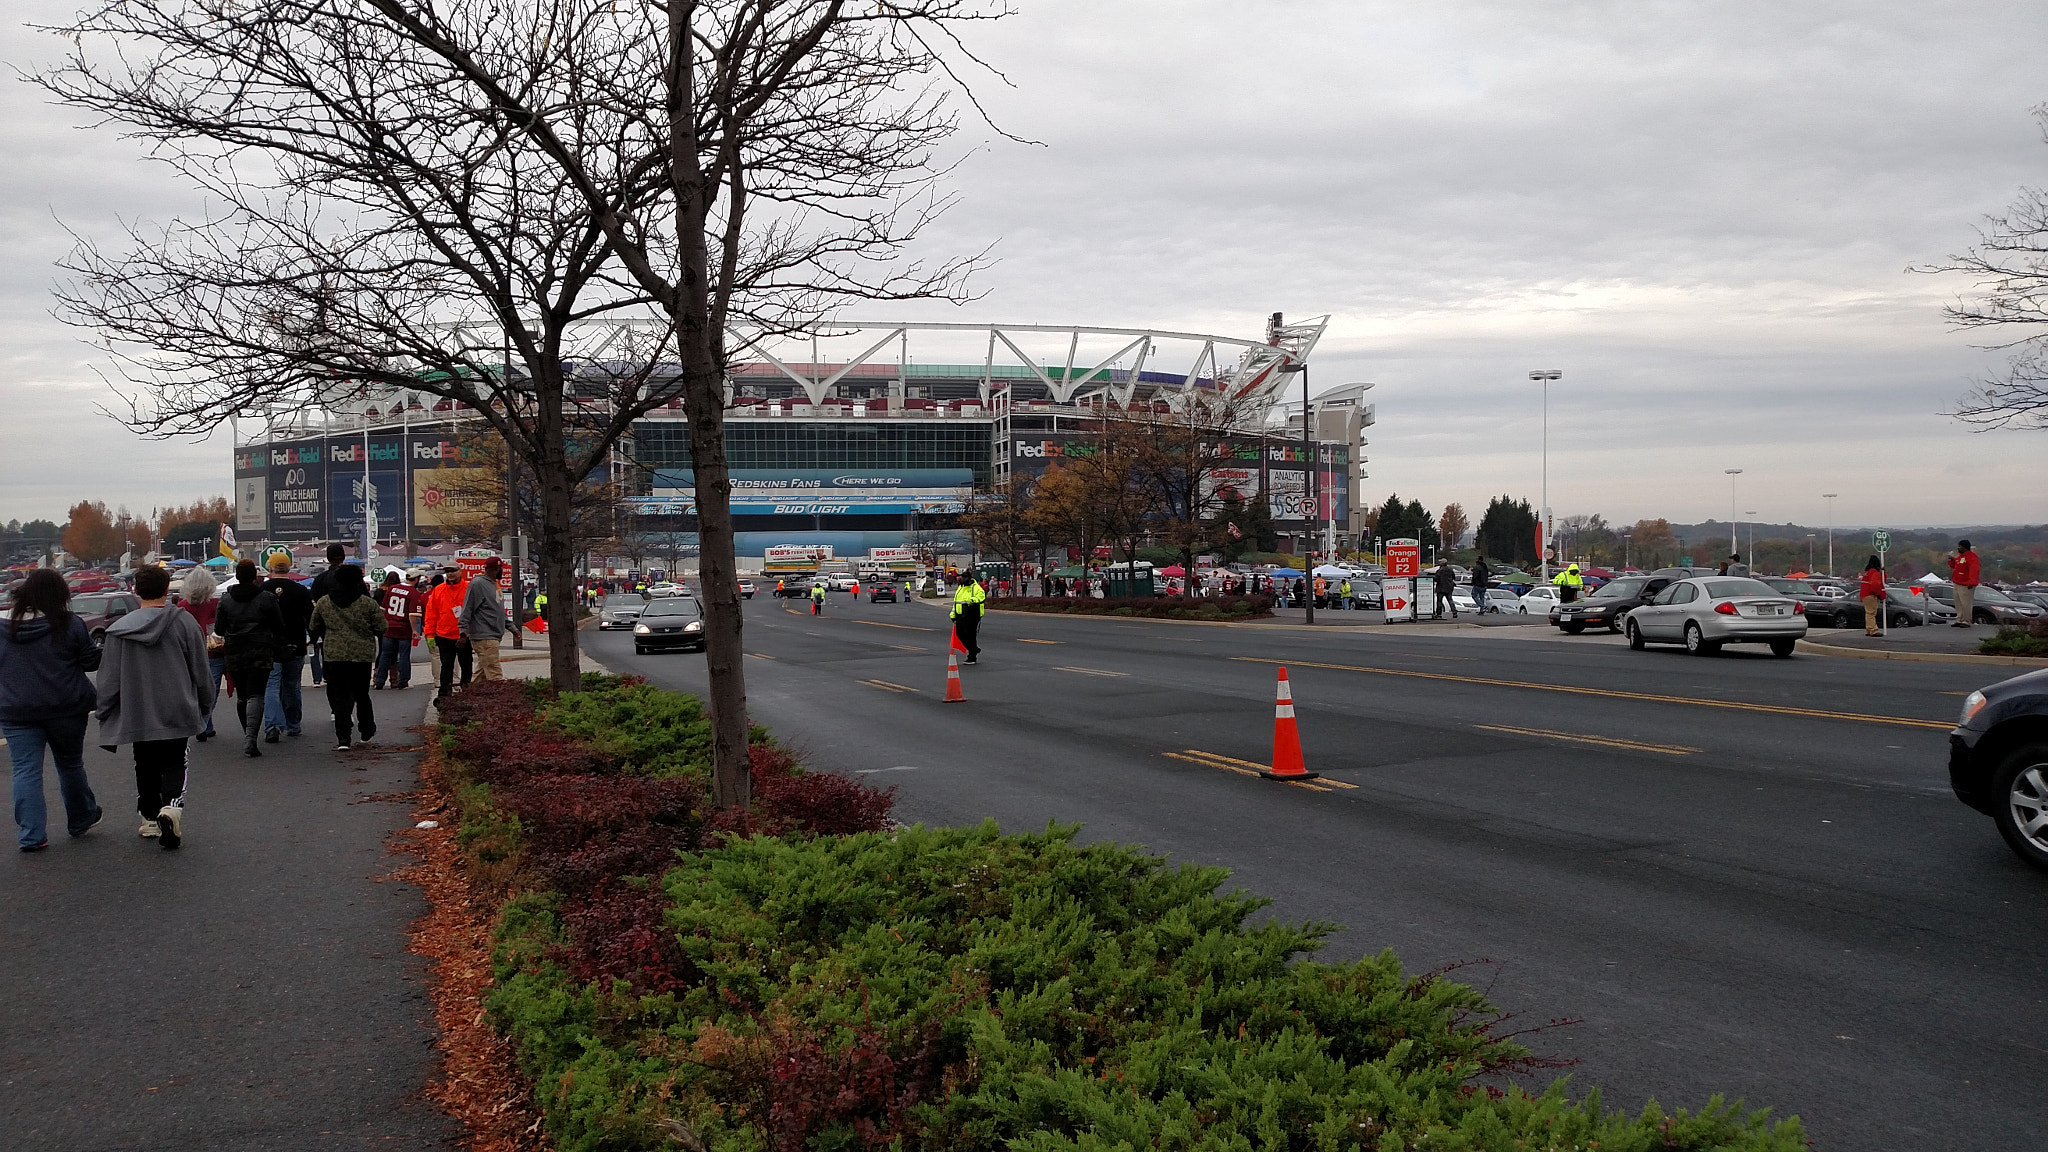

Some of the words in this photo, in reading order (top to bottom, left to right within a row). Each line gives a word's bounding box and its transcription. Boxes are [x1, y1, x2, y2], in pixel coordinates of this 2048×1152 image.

[271, 446, 320, 466] FedExField
[1274, 471, 1305, 481] ANALYTIC
[790, 479, 821, 488] FANS
[273, 489, 297, 501] PURPLE
[298, 488, 320, 500] HEART
[273, 500, 320, 514] FOUNDATION
[774, 504, 805, 514] BUD
[811, 504, 850, 514] LIGHT
[1876, 531, 1887, 539] GO
[1388, 549, 1417, 557] Orange
[460, 562, 486, 573] Orang
[1395, 564, 1410, 573] F2
[500, 578, 512, 586] G2
[388, 595, 406, 617] 91
